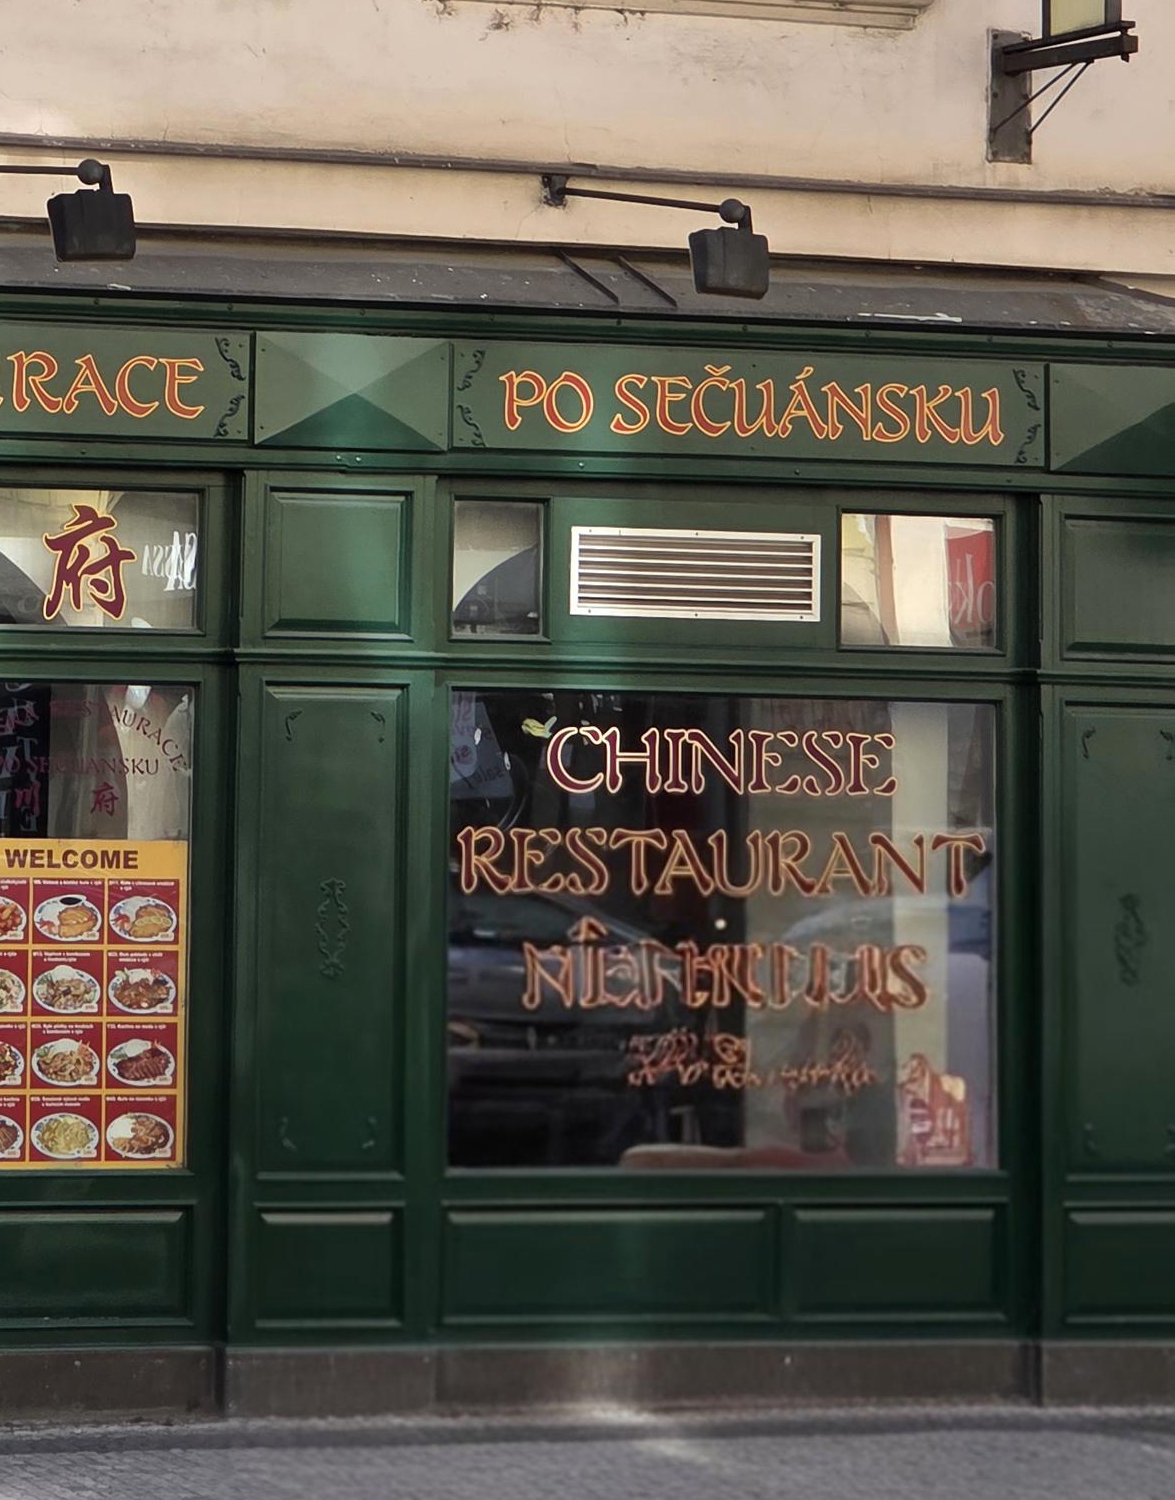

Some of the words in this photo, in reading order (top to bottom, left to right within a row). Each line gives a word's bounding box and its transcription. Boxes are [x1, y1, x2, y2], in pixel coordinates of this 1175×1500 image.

[499, 369, 595, 432] PO
[610, 363, 1005, 446] SEČUÁNSKU
[41, 503, 138, 621] 府
[546, 725, 899, 796] CHINESE
[4, 848, 139, 870] WELCOME
[457, 825, 987, 898] RESTAURANT
